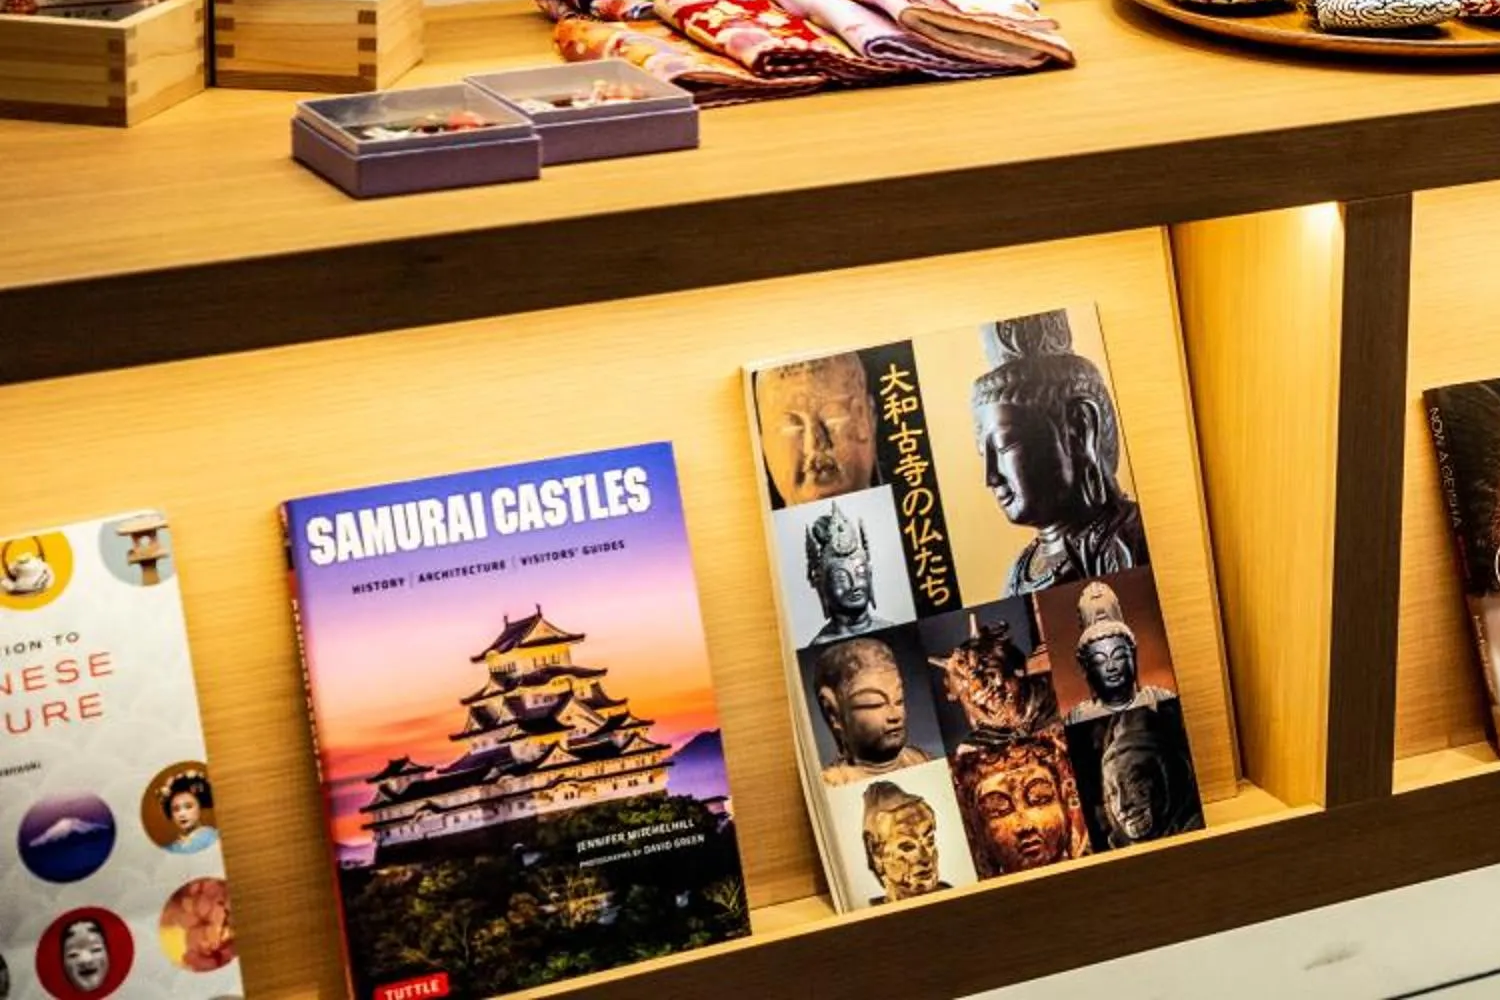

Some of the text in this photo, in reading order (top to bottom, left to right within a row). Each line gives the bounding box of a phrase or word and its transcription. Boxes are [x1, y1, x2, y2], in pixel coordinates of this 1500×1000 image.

[879, 363, 950, 606] 大和古寺の仏たち
[306, 491, 488, 567] SAMURAI
[491, 466, 651, 536] CASTLES
[351, 577, 405, 595] HISTORY
[417, 560, 506, 583] ARCHITECTURE
[582, 539, 626, 556] GUIDES
[53, 631, 80, 645] TO
[5, 692, 103, 734] URE
[576, 831, 625, 852] JENNIFER
[643, 840, 673, 856] DAVID
[673, 833, 705, 849] GREEN
[383, 978, 440, 1000] TUTTLE
